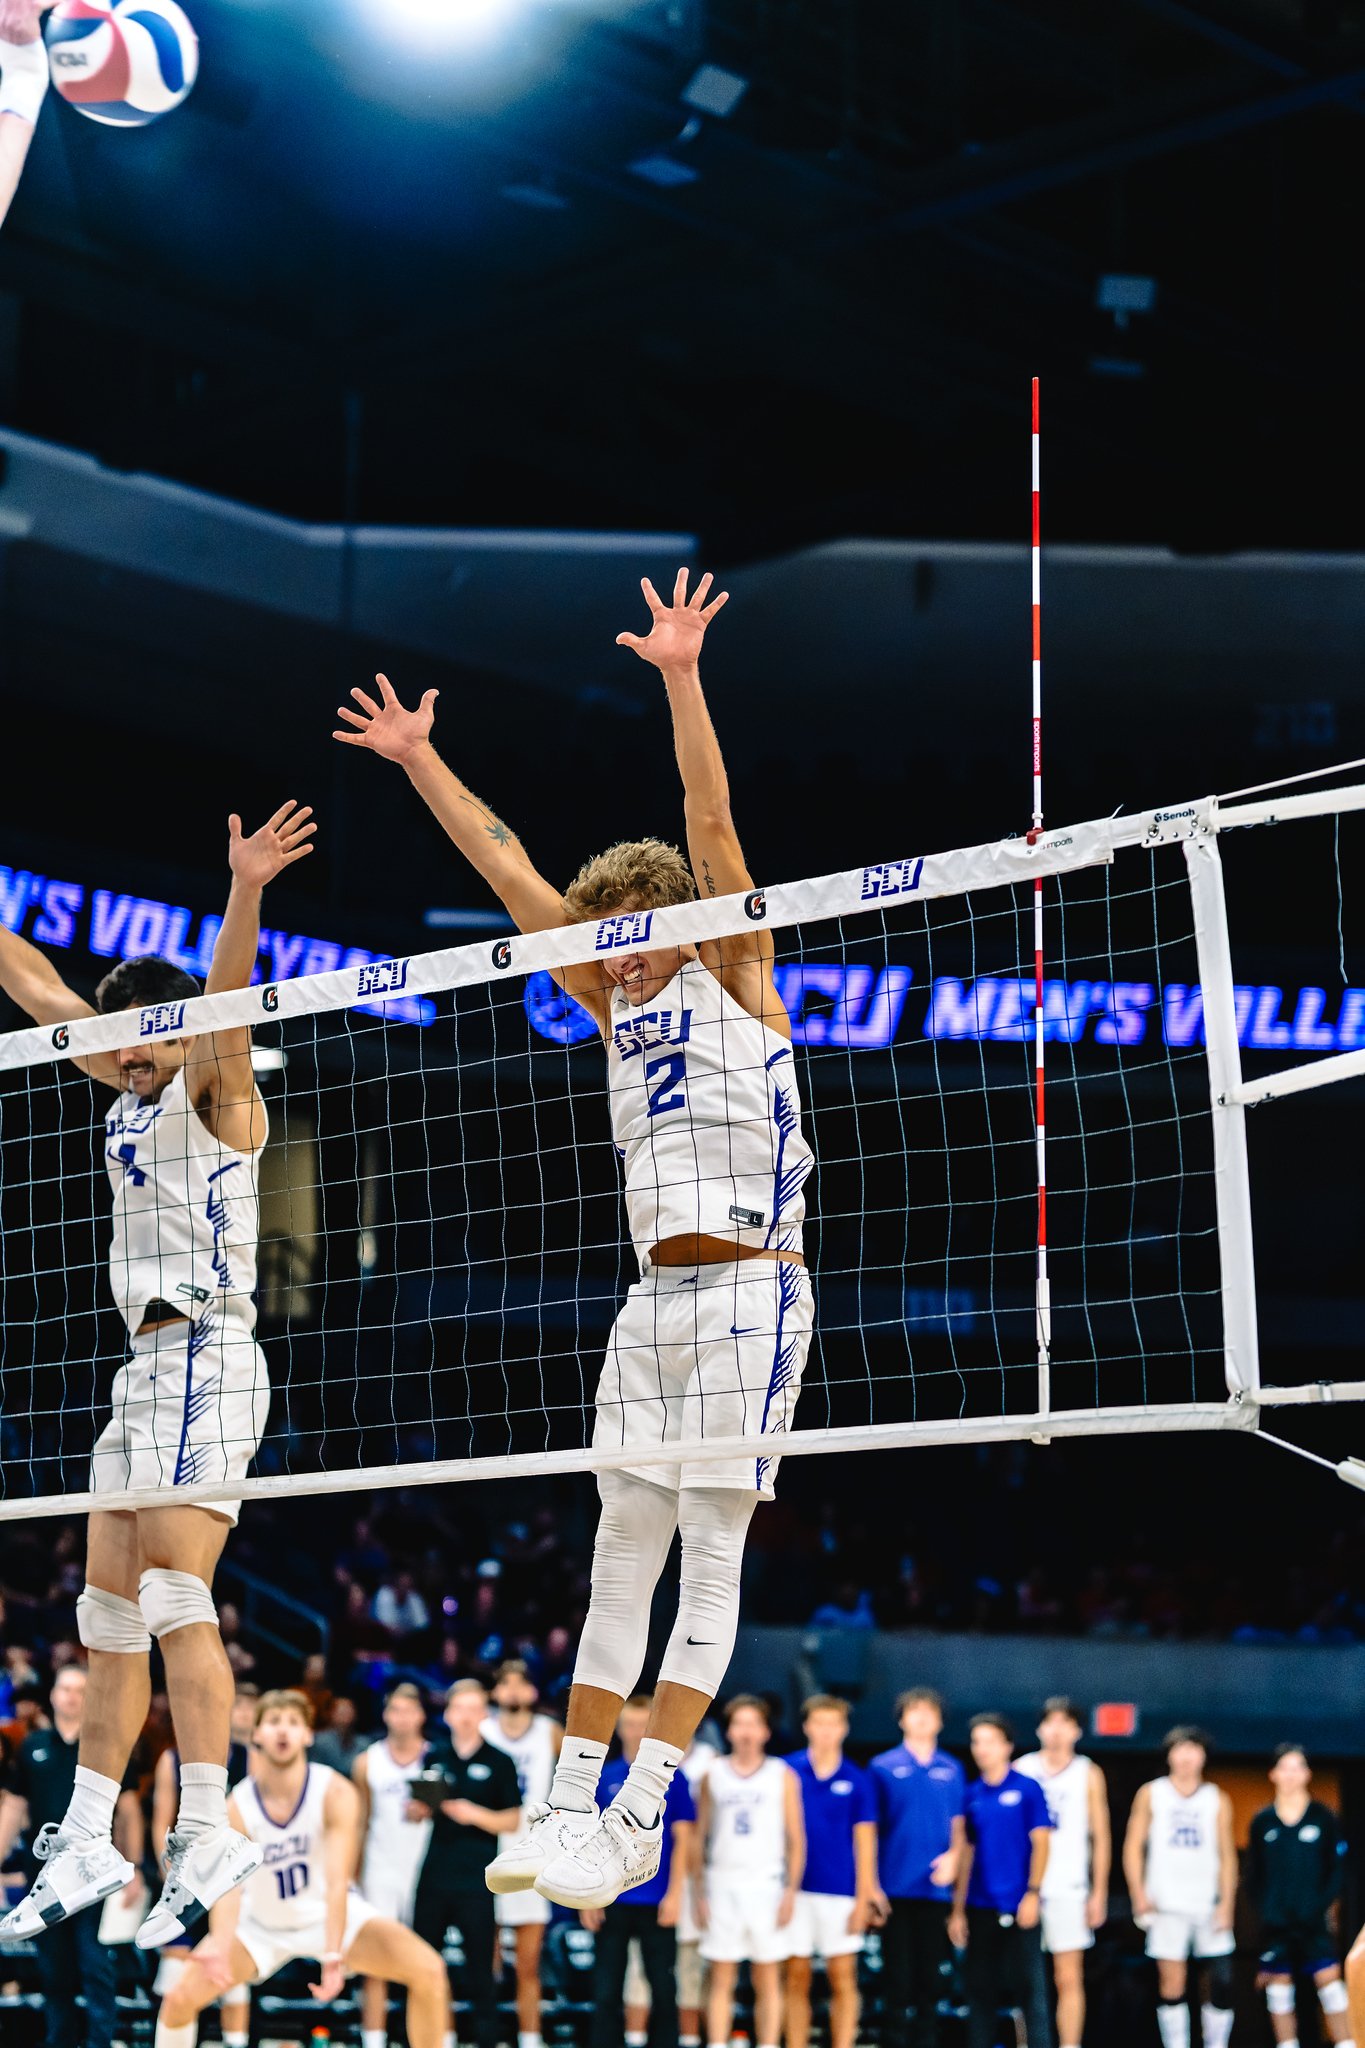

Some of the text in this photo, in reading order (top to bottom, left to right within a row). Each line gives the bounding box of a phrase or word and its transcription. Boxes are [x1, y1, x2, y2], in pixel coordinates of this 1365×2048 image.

[1163, 808, 1195, 821] Senoh
[861, 857, 925, 900] GCU
[744, 889, 766, 921] G
[595, 910, 654, 950] GCU
[492, 940, 512, 969] G
[357, 958, 410, 996] GCU
[262, 985, 279, 1012] G
[773, 963, 913, 1048] CU
[922, 976, 1155, 1046] MEN'S
[140, 1001, 186, 1036] GCU
[614, 1009, 694, 1061] GCU
[52, 1025, 69, 1050] G
[646, 1052, 687, 1118] 2
[274, 1862, 310, 1899] 10
